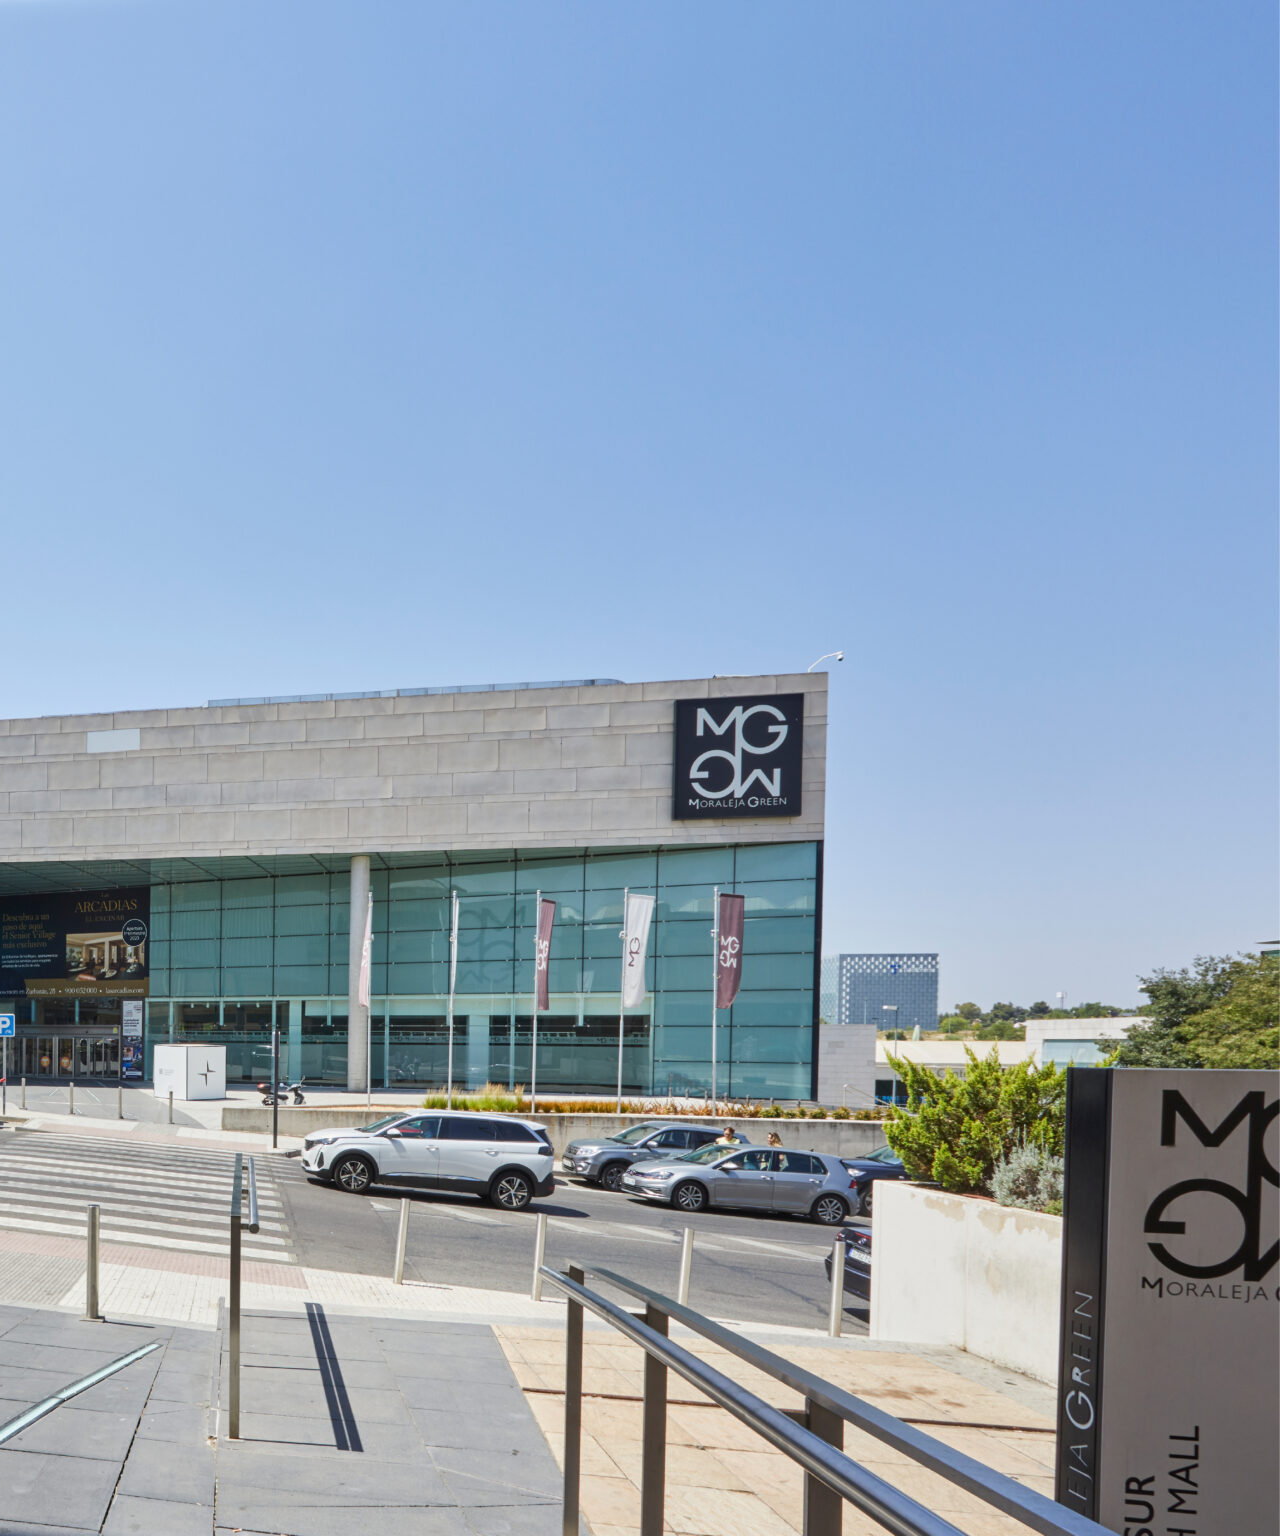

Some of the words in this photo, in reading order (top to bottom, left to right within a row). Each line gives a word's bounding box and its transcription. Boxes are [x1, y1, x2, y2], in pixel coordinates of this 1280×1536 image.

[688, 798, 745, 810] MORALEJA
[747, 796, 787, 808] GREEN
[74, 899, 138, 913] ARCADIAS
[1141, 1276, 1269, 1303] MORALEJA
[1065, 1290, 1095, 1430] GREEN
[1167, 1425, 1200, 1515] MALL
